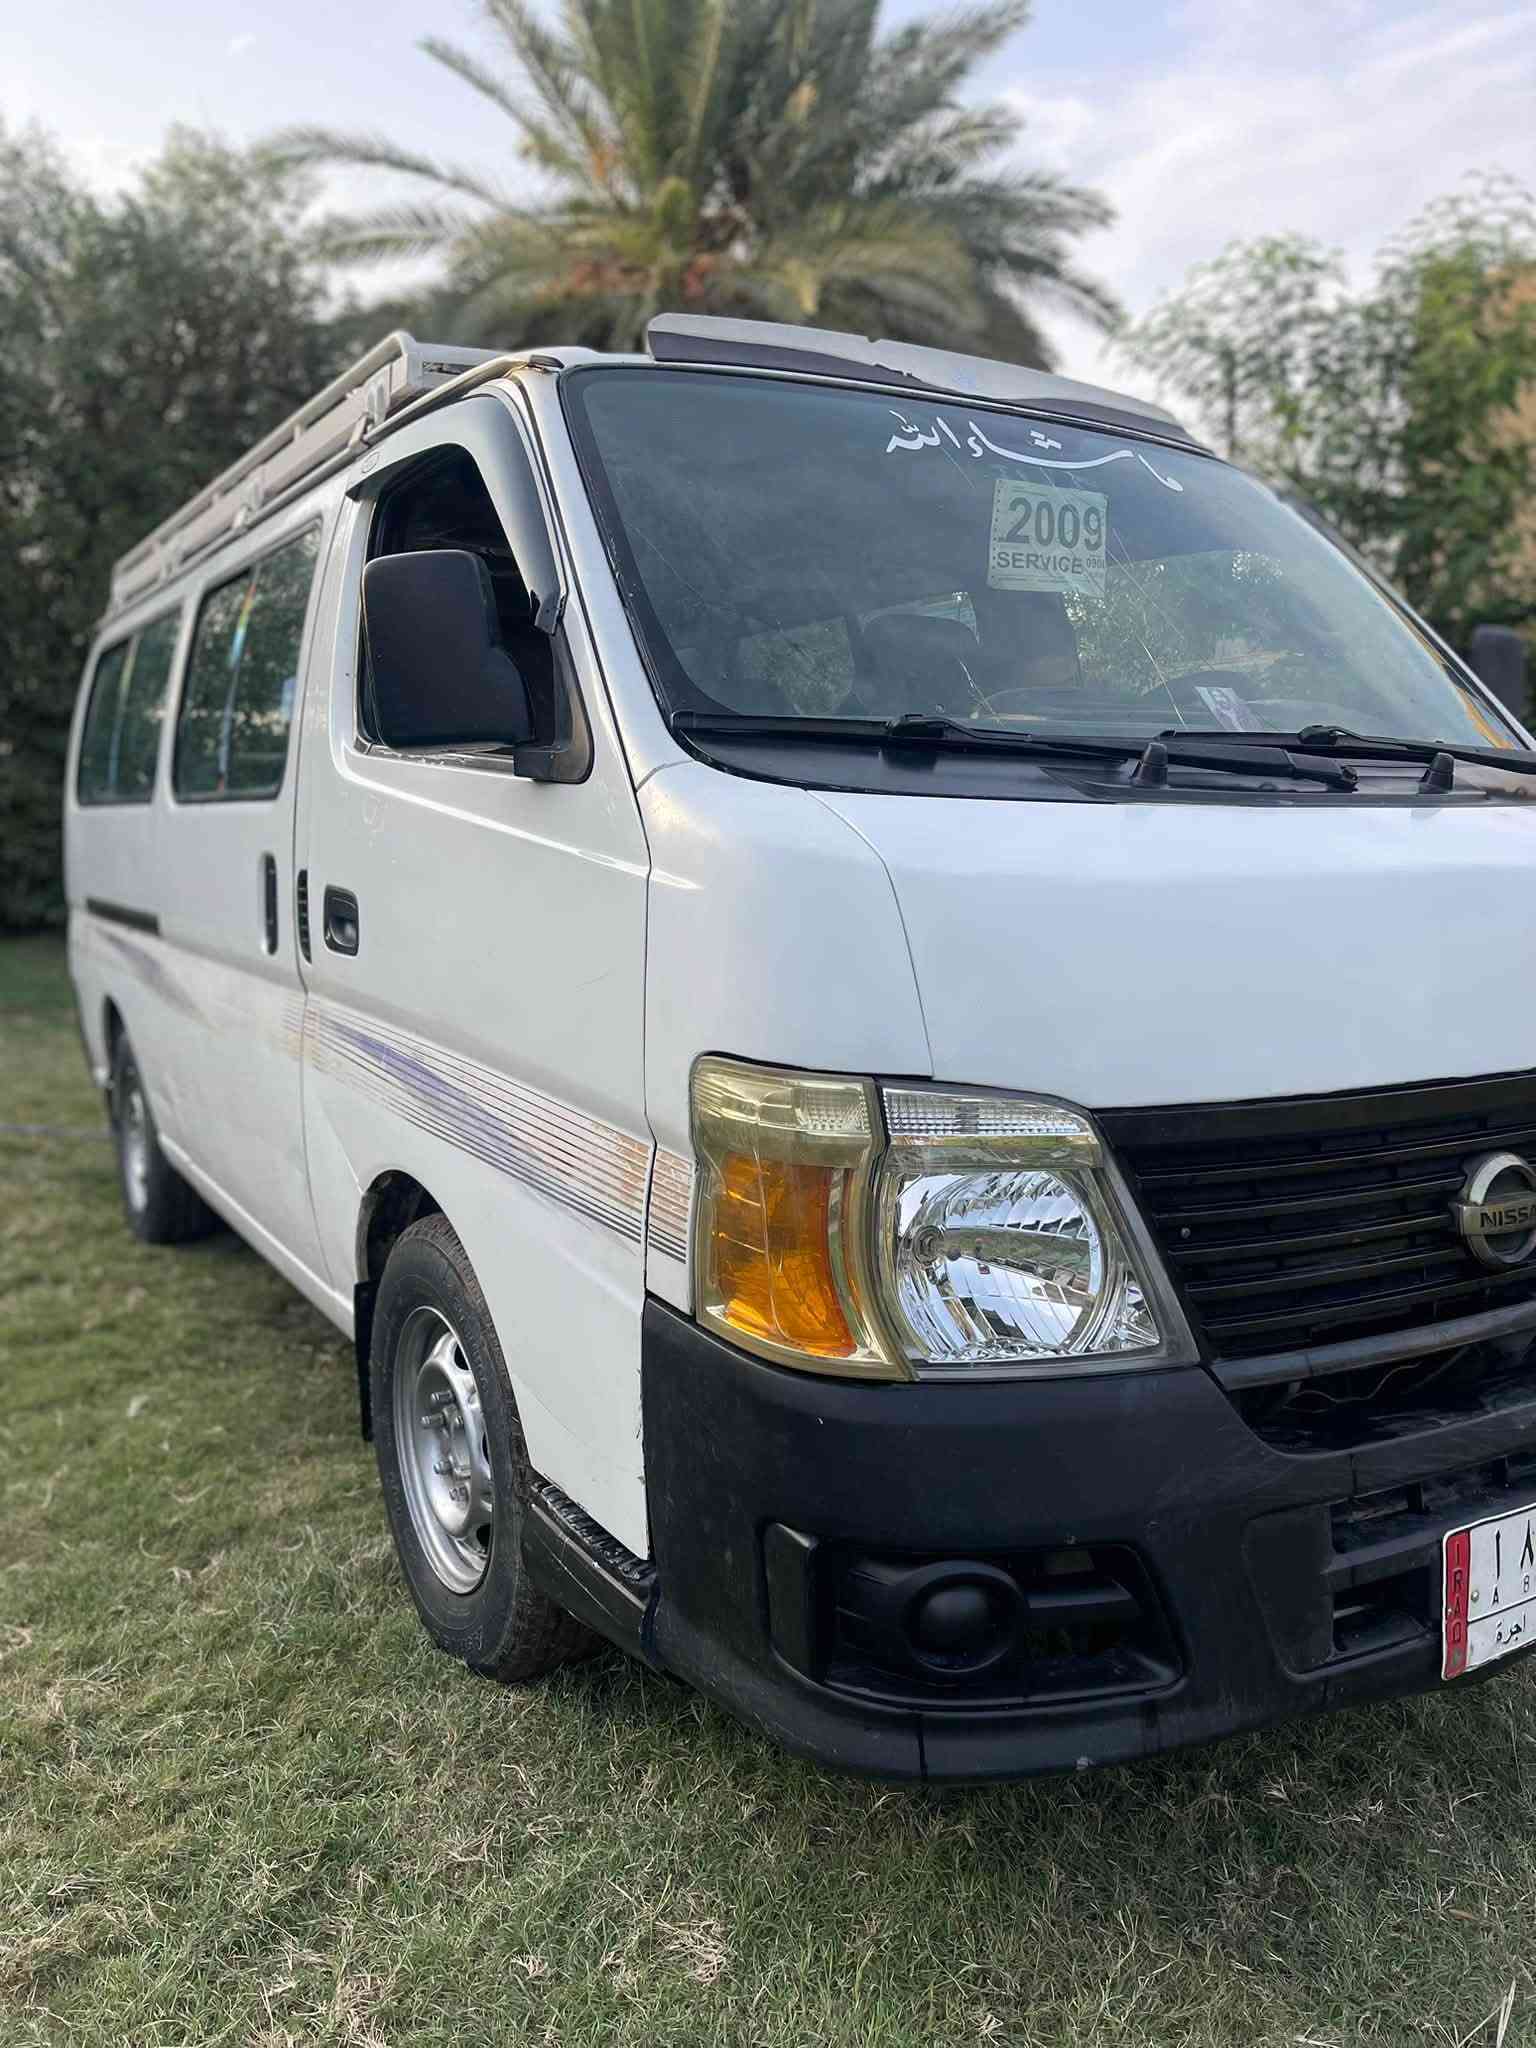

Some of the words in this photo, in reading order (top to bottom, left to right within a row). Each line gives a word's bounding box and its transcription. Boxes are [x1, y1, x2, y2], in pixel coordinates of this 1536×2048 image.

[885, 409, 962, 454] الله
[1006, 496, 1103, 552] 2009
[997, 551, 1083, 575] SERVICE
